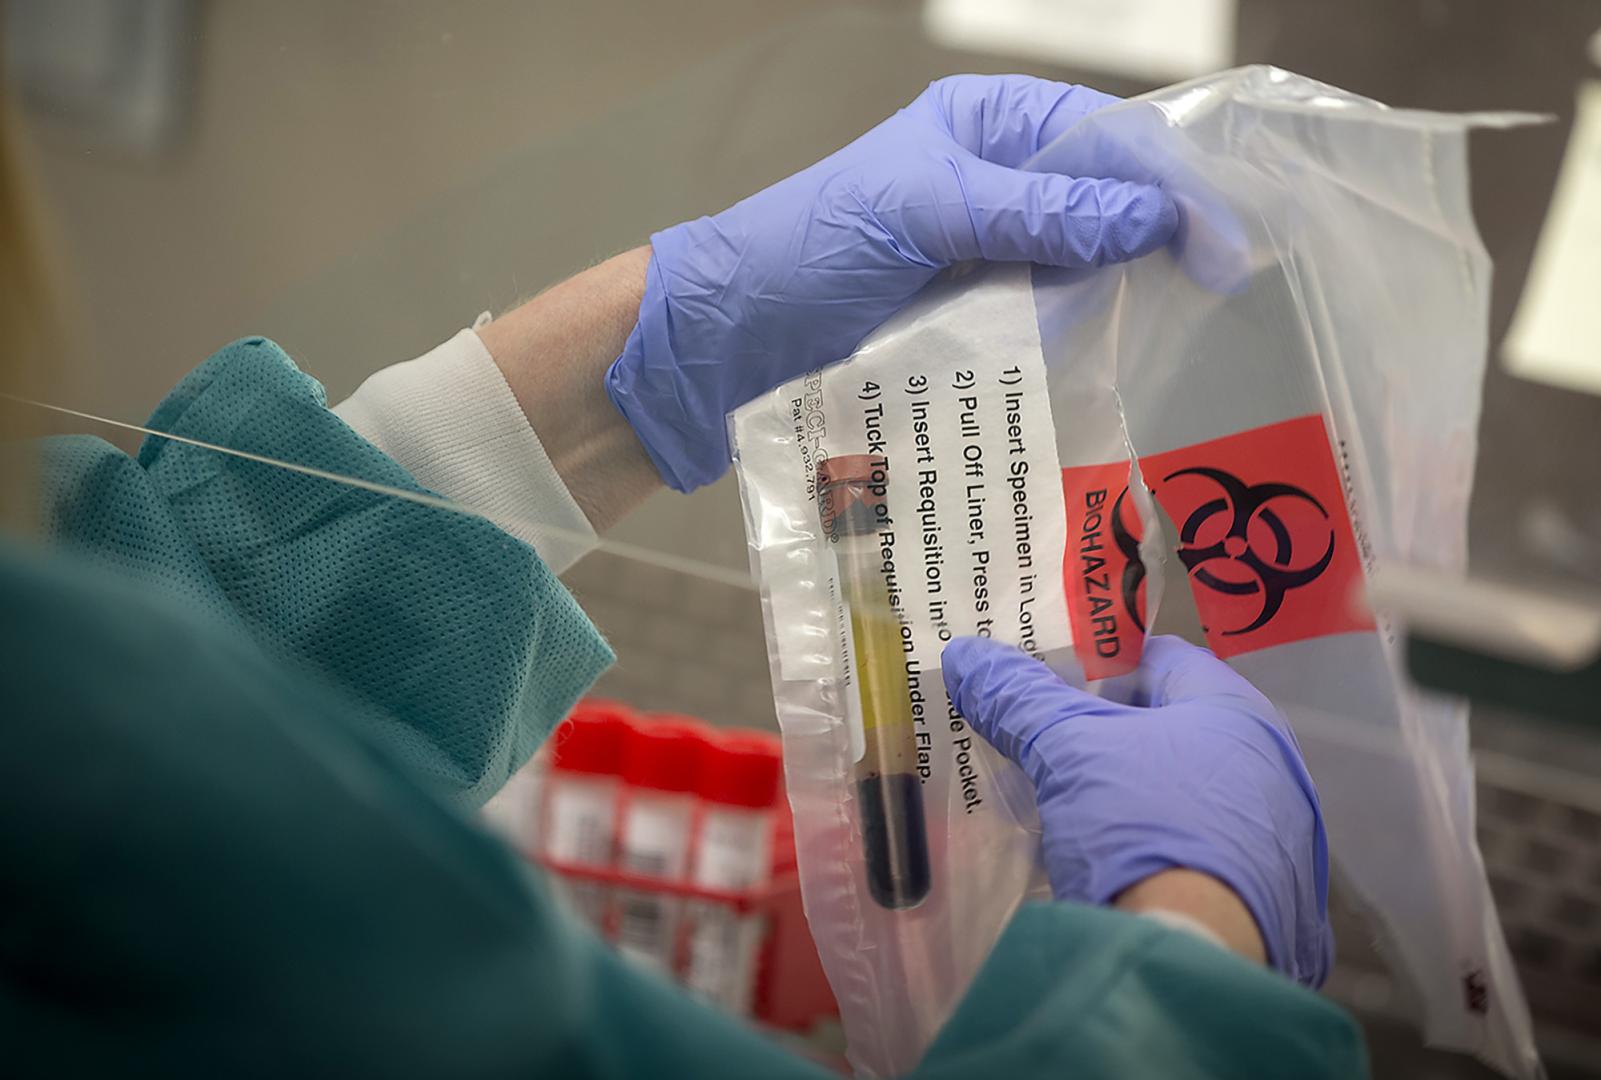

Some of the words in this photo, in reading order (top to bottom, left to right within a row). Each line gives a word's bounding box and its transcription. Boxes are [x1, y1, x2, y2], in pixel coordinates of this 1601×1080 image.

[857, 381, 882, 400] 4)
[904, 375, 929, 395] 3)
[951, 369, 976, 390] 2)
[998, 365, 1023, 386] 1)
[791, 398, 802, 421] Pat
[864, 403, 887, 454] Tuck
[958, 396, 981, 438] Pull
[1004, 392, 1026, 455] Insert
[911, 401, 935, 464] Insert
[866, 456, 890, 497] Top
[963, 444, 984, 478] Off
[874, 503, 893, 525] of
[916, 470, 945, 594] Requisition
[966, 484, 986, 545] Liner,
[1006, 460, 1033, 569] Specimen
[971, 550, 990, 613] Press
[1019, 574, 1037, 594] in
[1080, 488, 1121, 659] BIOHAZARD
[928, 600, 952, 642] into
[975, 618, 994, 639] to
[905, 661, 926, 725] Under
[915, 732, 932, 785] Flap.
[952, 736, 983, 815] Pocket.
